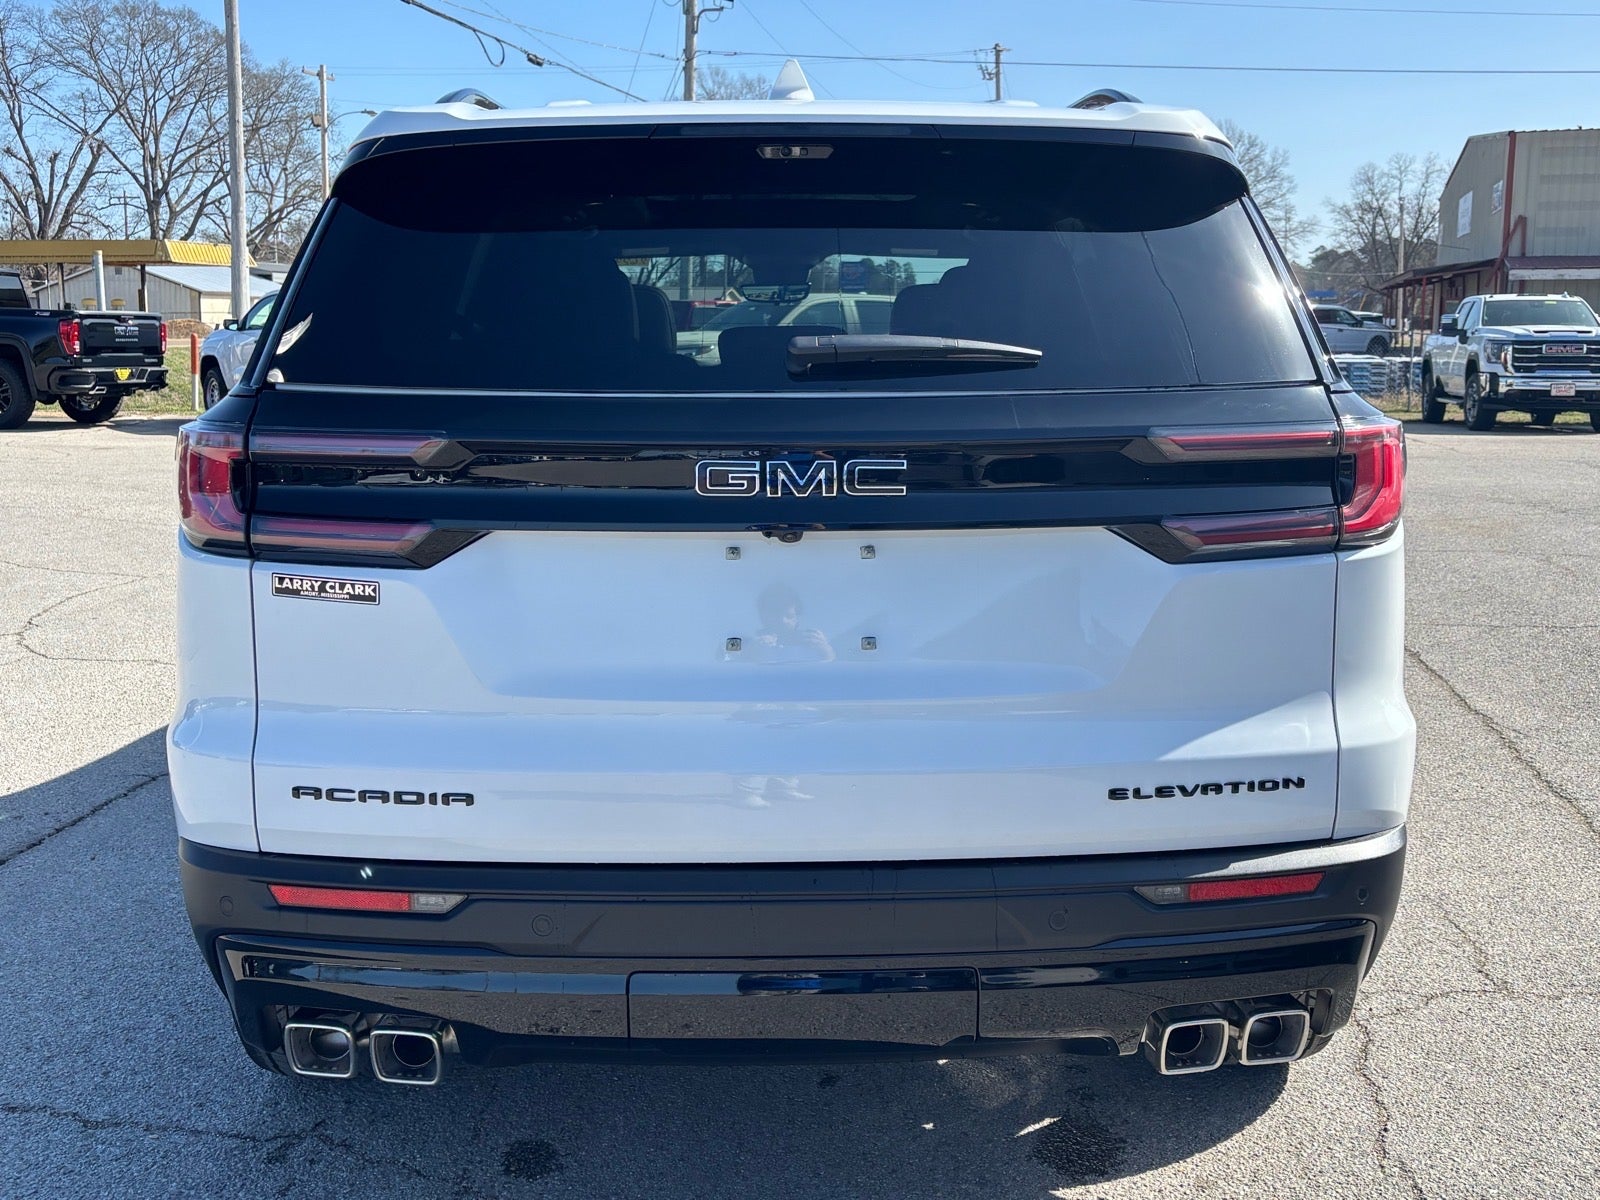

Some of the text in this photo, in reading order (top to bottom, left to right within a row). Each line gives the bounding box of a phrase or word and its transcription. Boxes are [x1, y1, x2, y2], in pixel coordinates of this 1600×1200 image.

[695, 459, 907, 497] GMC
[275, 577, 376, 596] LARRY CLARK
[291, 785, 475, 807] ACADIA
[1108, 777, 1305, 800] ELEVATION
